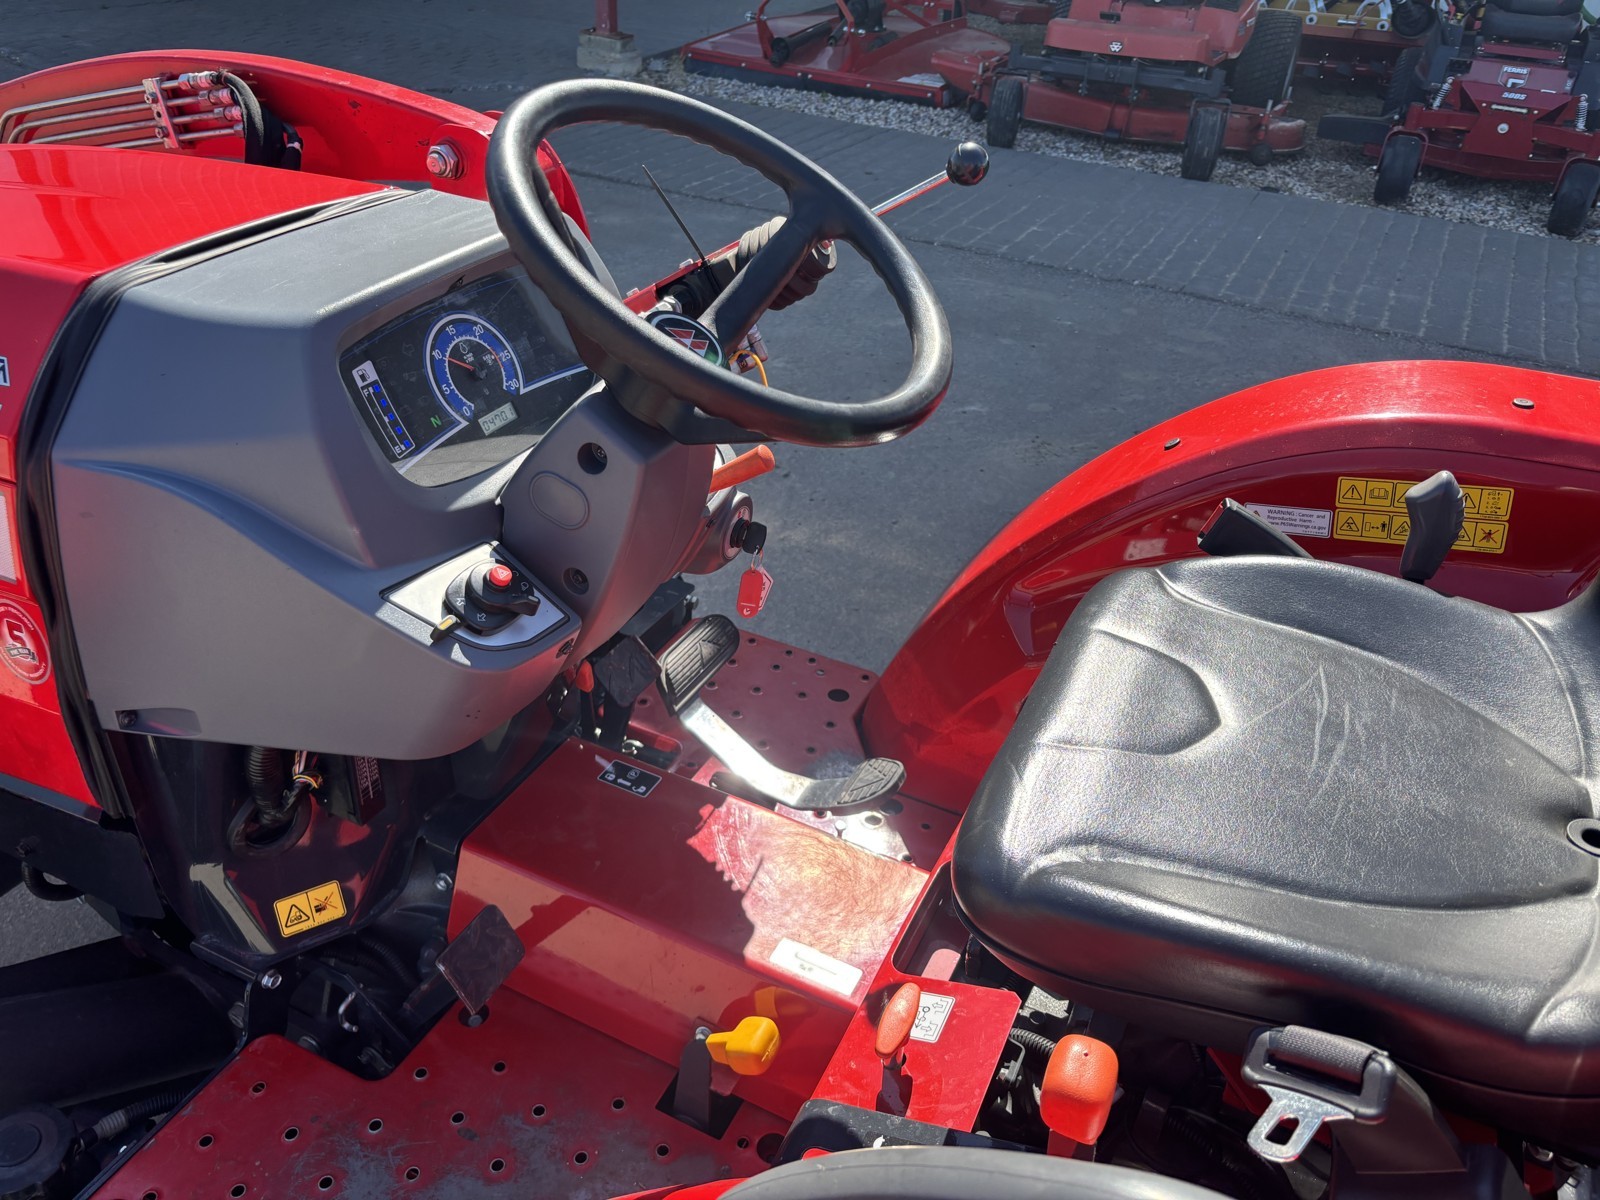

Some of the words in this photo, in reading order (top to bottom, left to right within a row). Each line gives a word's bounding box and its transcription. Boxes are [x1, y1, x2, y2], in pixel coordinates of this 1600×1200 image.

[1503, 66, 1528, 74] FERRIS
[445, 325, 456, 336] 15
[473, 324, 484, 336] 20
[431, 349, 443, 360] 10
[500, 350, 511, 361] 25
[442, 384, 450, 394] 5
[508, 378, 520, 390] 30
[363, 388, 369, 398] F
[462, 406, 470, 416] 0
[430, 415, 442, 428] N
[394, 445, 402, 454] E
[1267, 514, 1298, 522] Reproductive
